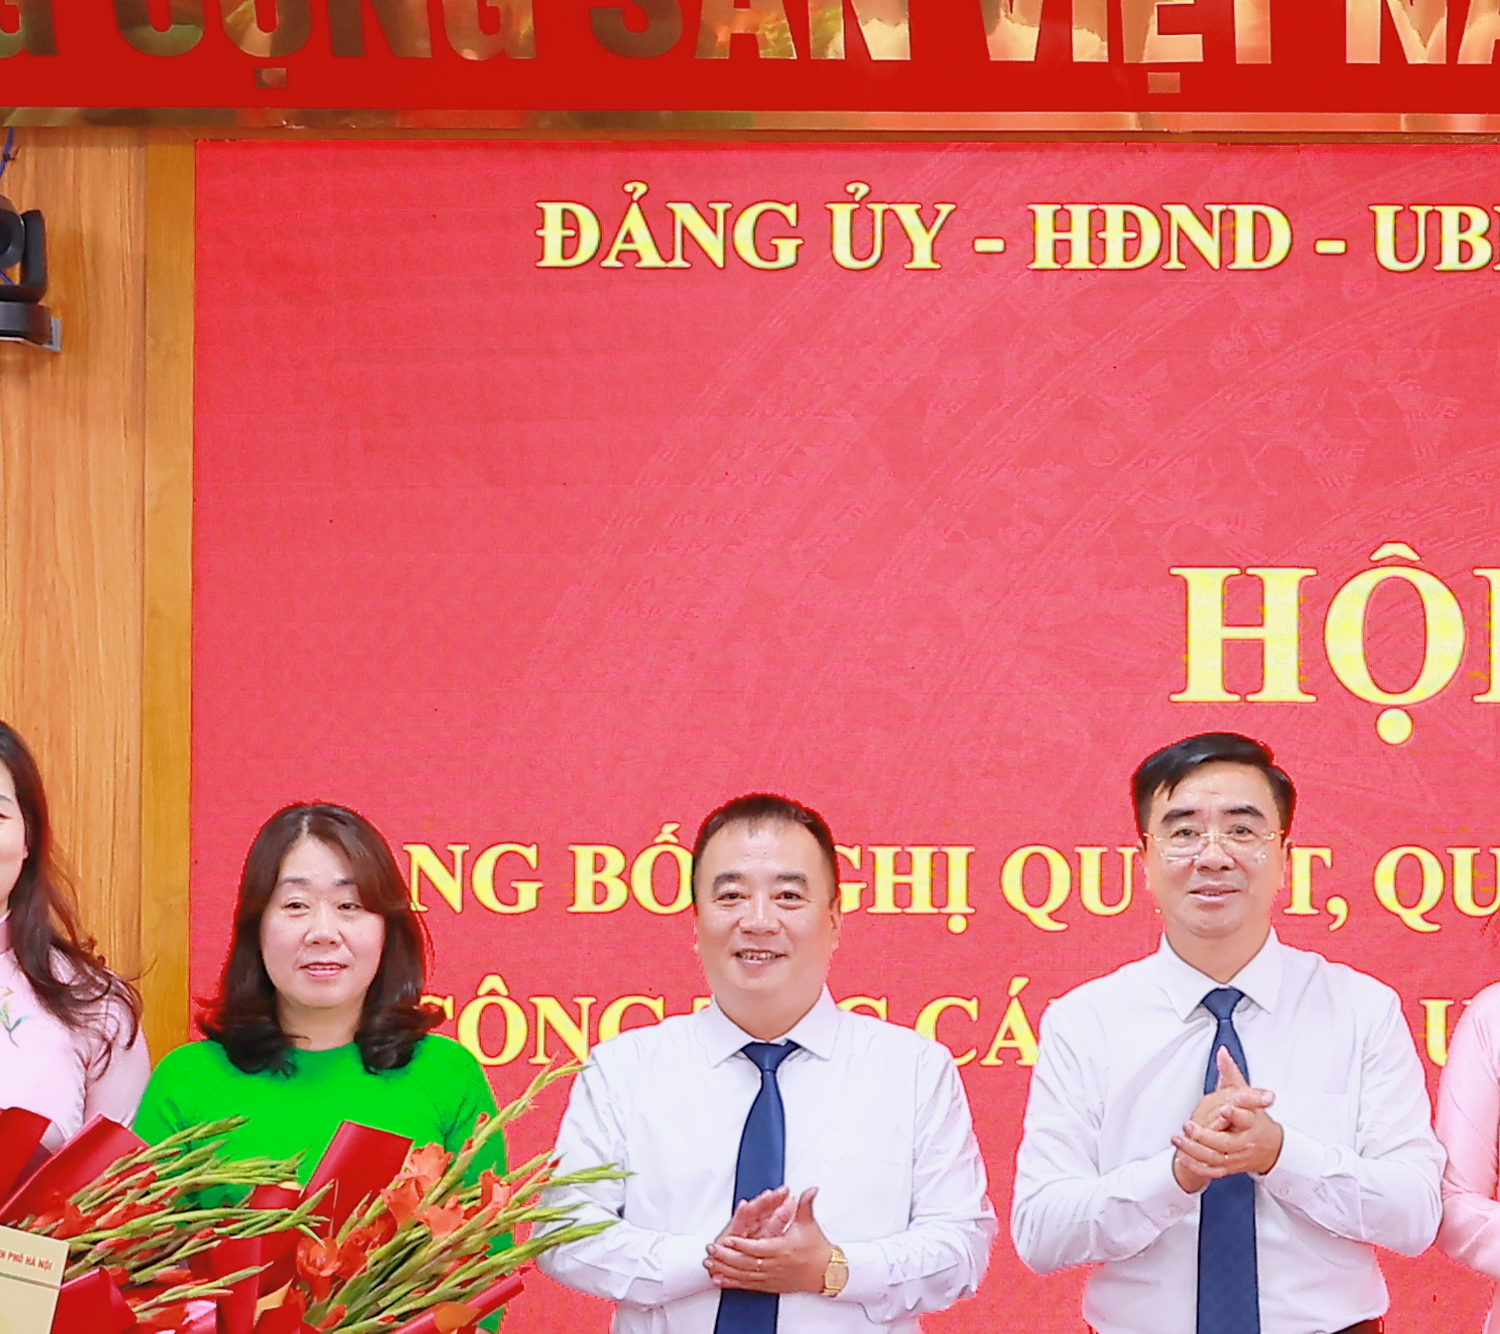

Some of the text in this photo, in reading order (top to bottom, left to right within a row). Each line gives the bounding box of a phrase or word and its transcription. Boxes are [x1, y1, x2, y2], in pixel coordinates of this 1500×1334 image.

[535, 179, 805, 271] ĐẢNG
[824, 180, 957, 271] ỦY
[972, 237, 1006, 254] -
[1028, 202, 1293, 271] HĐND
[1314, 238, 1348, 255] -
[564, 822, 695, 915] BỐ
